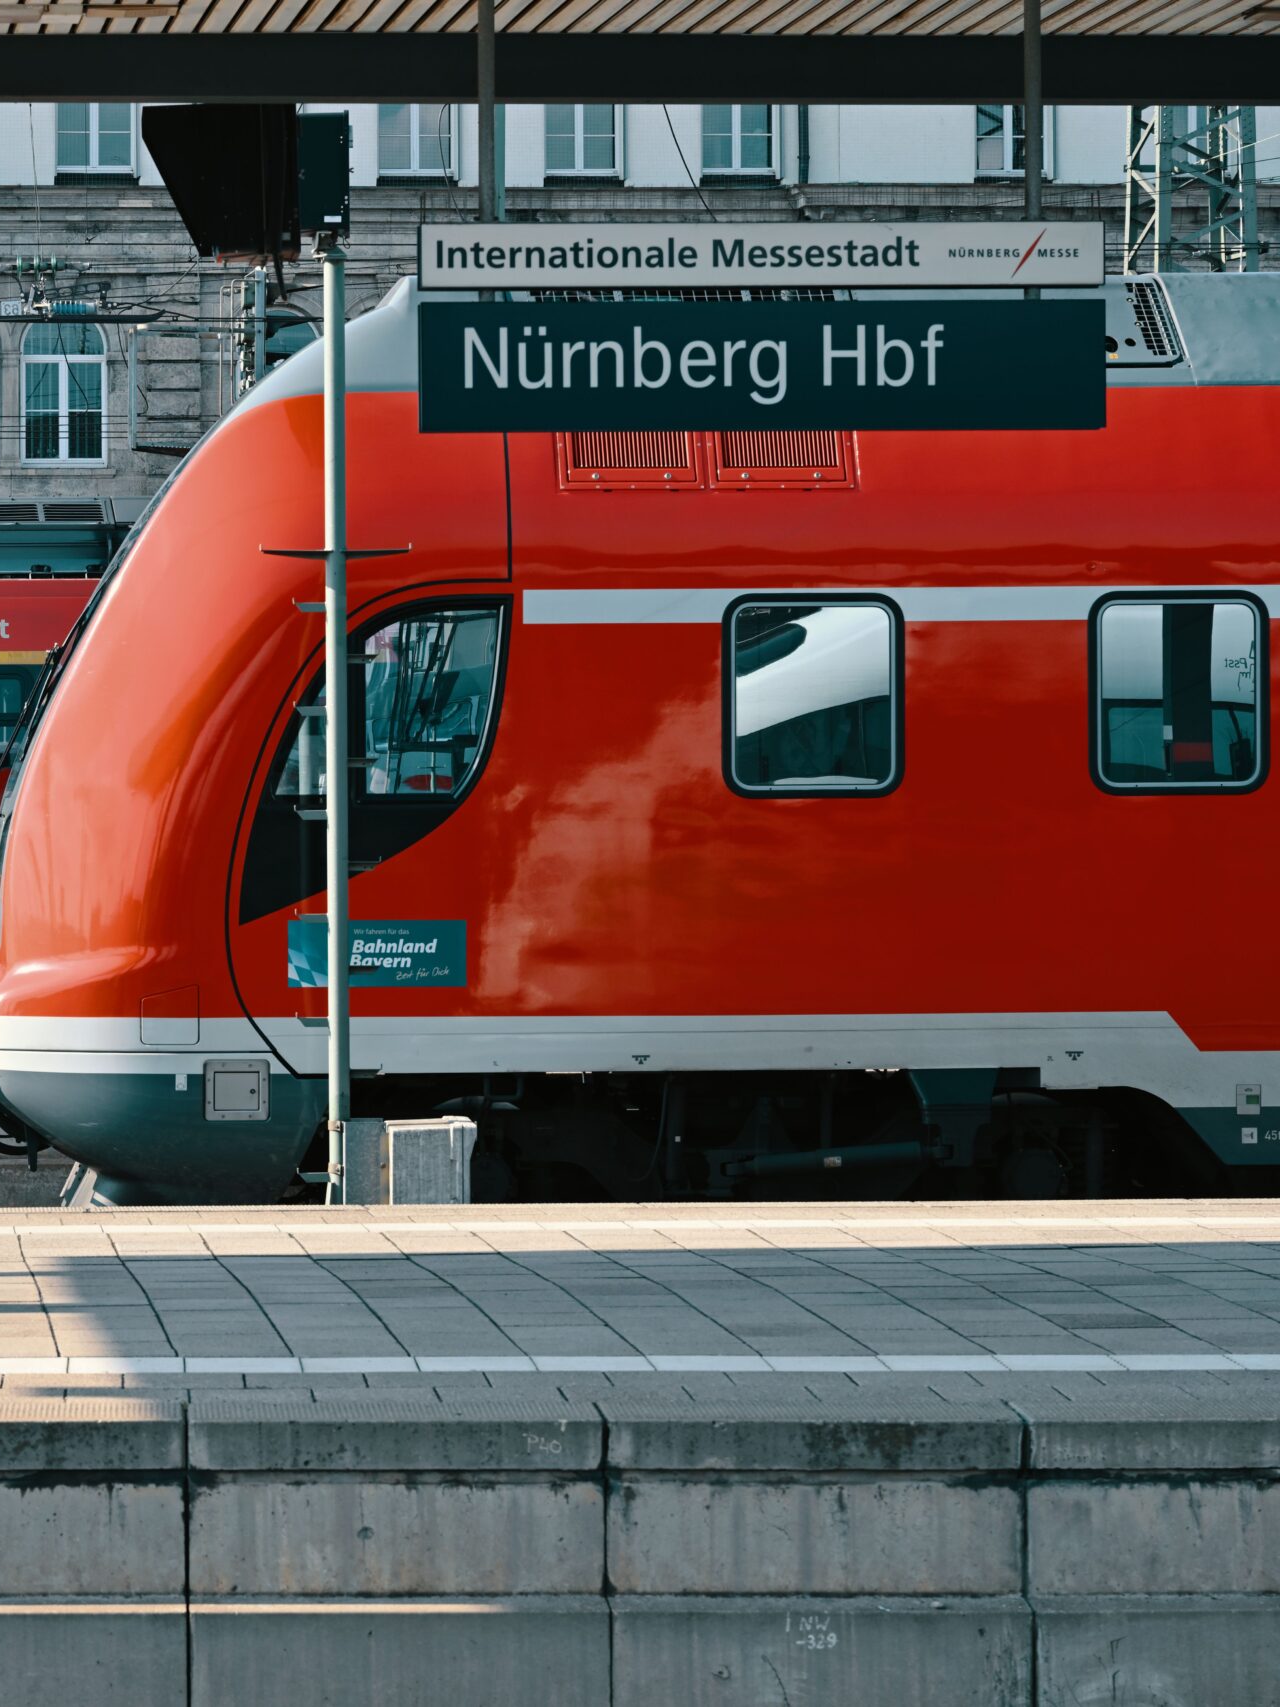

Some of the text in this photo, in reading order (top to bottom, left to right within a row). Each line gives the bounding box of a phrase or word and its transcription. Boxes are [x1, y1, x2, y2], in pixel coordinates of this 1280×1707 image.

[436, 236, 920, 269] Internationale Messestadt
[948, 247, 1079, 258] NÜRNBERG MESSE
[464, 323, 945, 405] Nürnberg Hbf
[351, 938, 438, 954] Bahnland
[1264, 1130, 1280, 1141] 45
